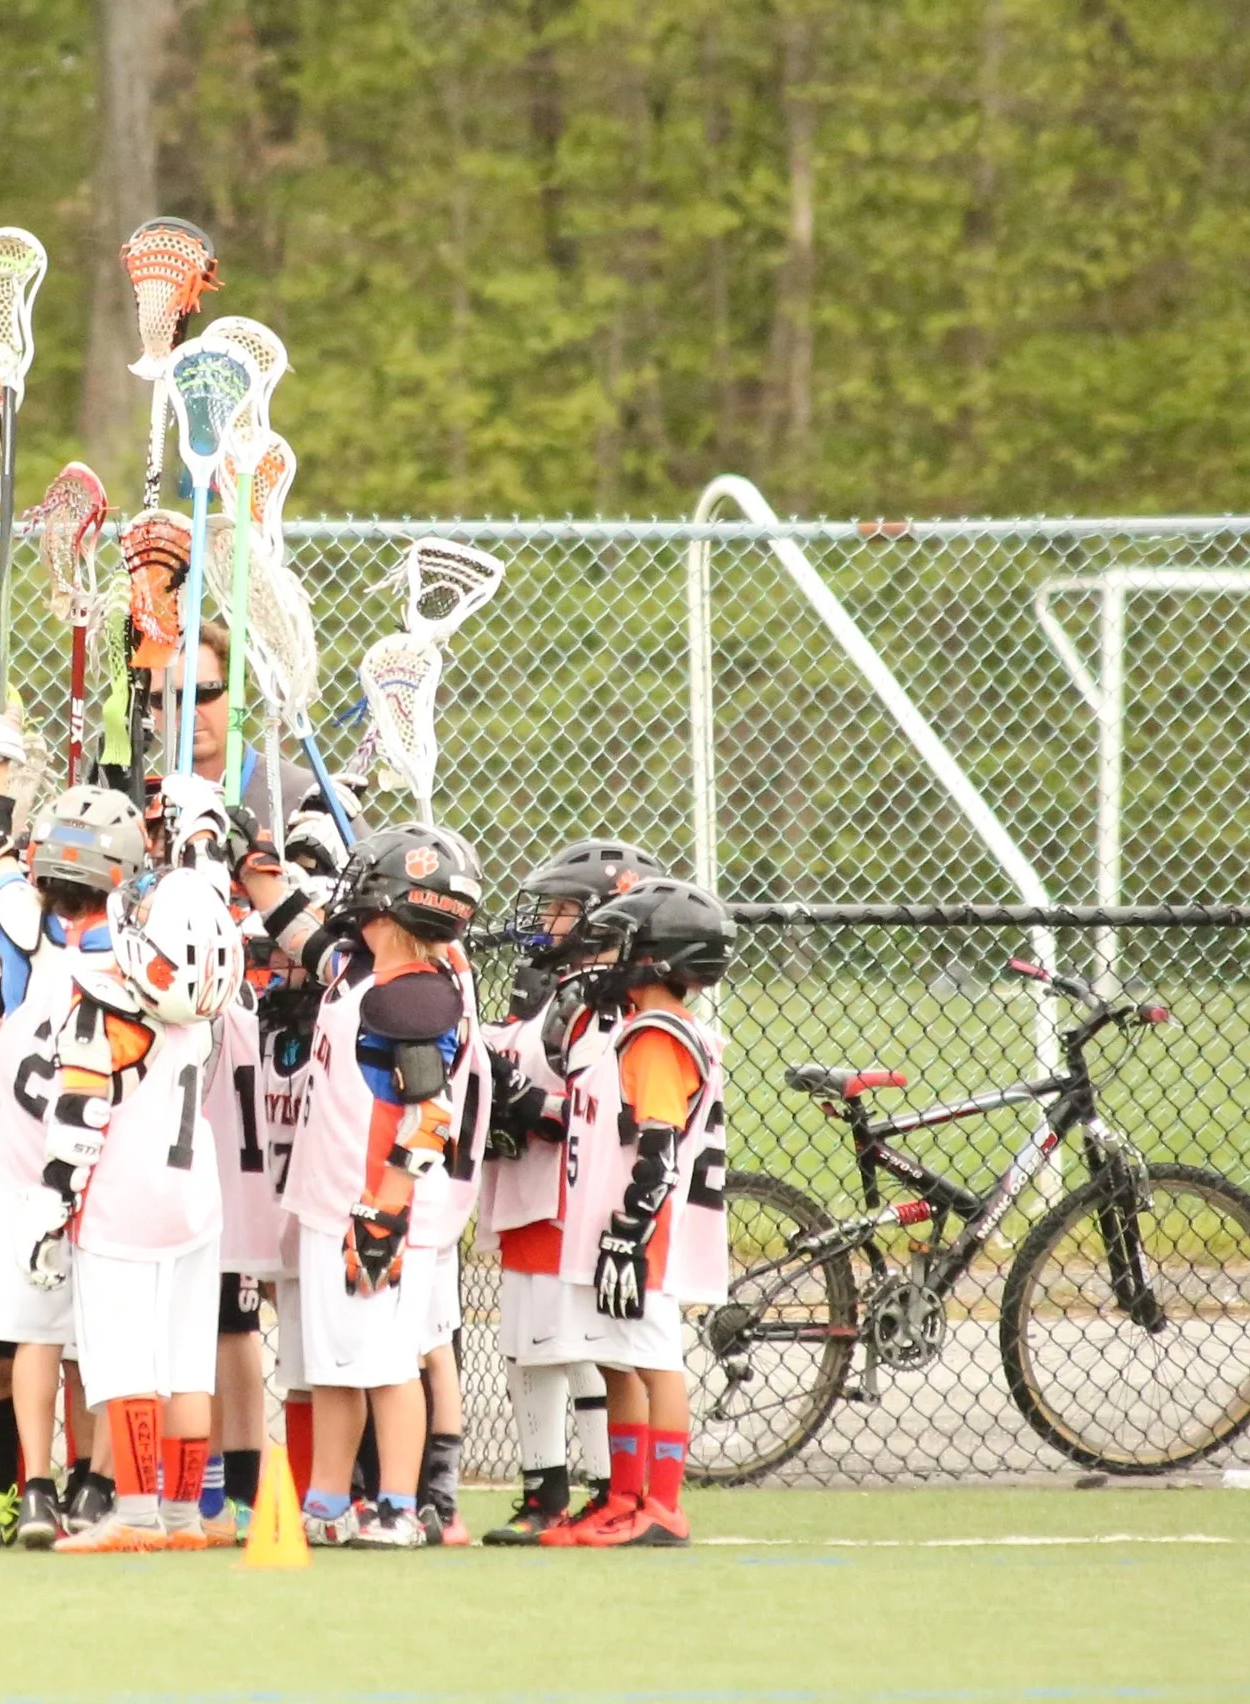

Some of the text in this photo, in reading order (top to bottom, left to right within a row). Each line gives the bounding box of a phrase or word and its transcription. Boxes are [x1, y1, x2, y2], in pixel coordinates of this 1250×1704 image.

[166, 1063, 198, 1171] 1
[234, 1065, 264, 1173] 1
[351, 1203, 380, 1221] STX
[600, 1235, 637, 1255] STX
